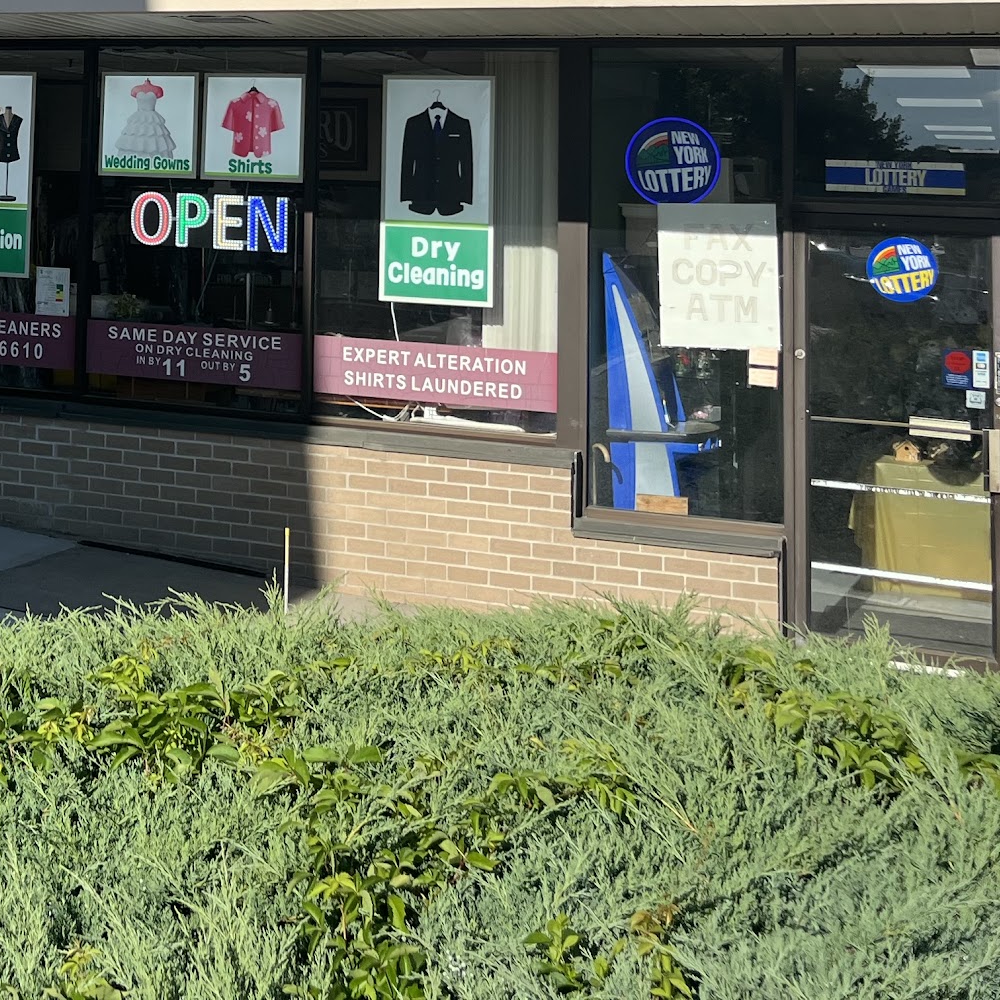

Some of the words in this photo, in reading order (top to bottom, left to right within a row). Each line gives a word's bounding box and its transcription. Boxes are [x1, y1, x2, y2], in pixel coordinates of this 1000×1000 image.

[671, 131, 700, 145] NEW
[104, 155, 150, 171] Wedding
[153, 156, 190, 171] Gowns
[228, 159, 273, 174] Shirts
[673, 146, 709, 165] YORK
[637, 165, 712, 193] LOTTERY
[864, 167, 927, 187] LOTTERY
[131, 191, 289, 253] OPEN
[411, 236, 461, 261] Dry
[683, 223, 755, 252] FAX
[896, 244, 922, 255] NEW
[672, 258, 768, 288] COPY
[900, 254, 931, 271] YORK
[387, 261, 485, 290] Cleaning
[873, 268, 934, 294] LOTTERY
[686, 293, 758, 324] ATM
[108, 326, 158, 343] SAME
[162, 330, 198, 345] DAY
[202, 332, 282, 350] SERVICE
[135, 343, 153, 354] ON
[156, 345, 182, 356] DRY
[185, 347, 253, 362] CLEANING
[342, 346, 411, 366] EXPERT
[414, 352, 527, 376] ALTERATION
[136, 356, 146, 365] IN
[148, 356, 161, 366] BY
[162, 358, 186, 377] 11
[200, 360, 221, 371] OUT
[222, 361, 236, 372] BY
[238, 364, 251, 382] 5
[344, 370, 407, 390] SHIRTS
[411, 375, 523, 399] LAUNDERED
